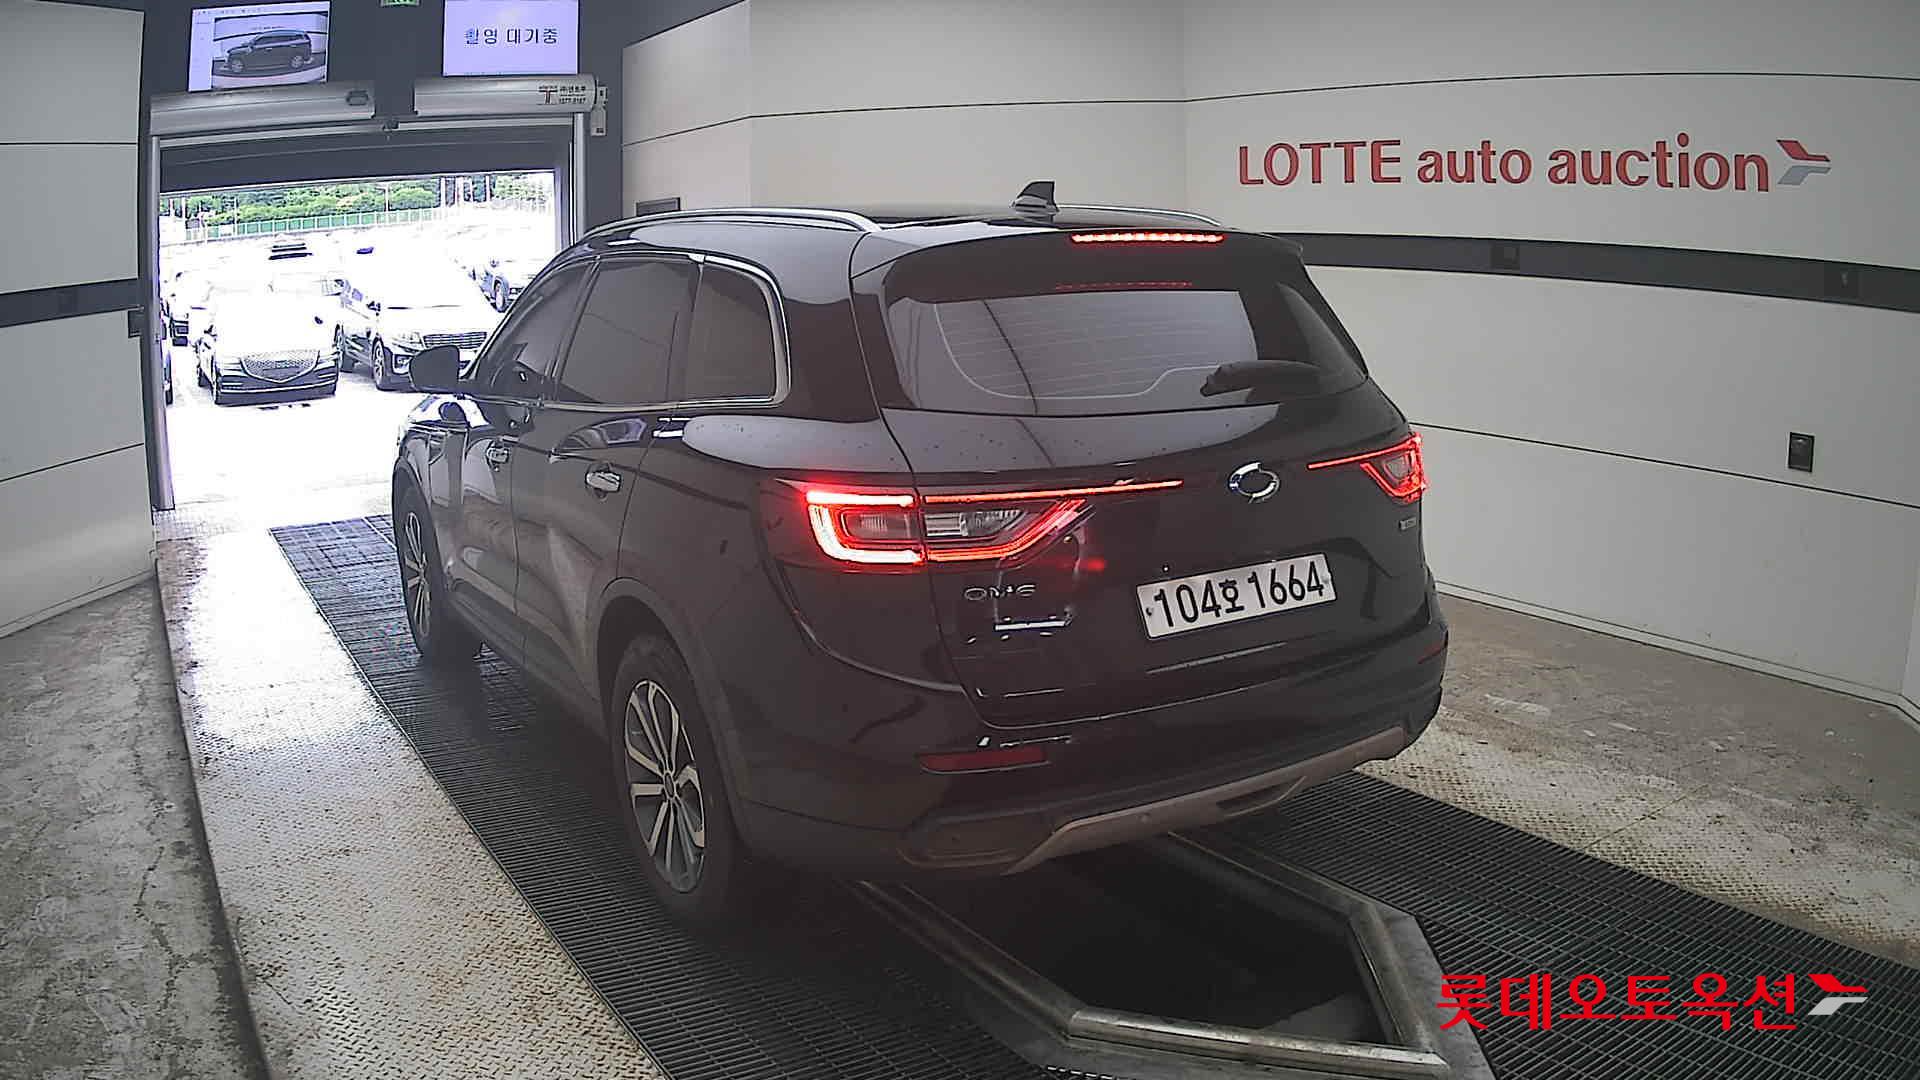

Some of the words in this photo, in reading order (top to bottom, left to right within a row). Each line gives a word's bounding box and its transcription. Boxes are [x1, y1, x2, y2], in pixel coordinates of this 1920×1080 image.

[506, 27, 559, 45] 대기중
[1239, 139, 1402, 186] LOTTE
[1416, 140, 1532, 184] auto
[1547, 132, 1769, 193] auction
